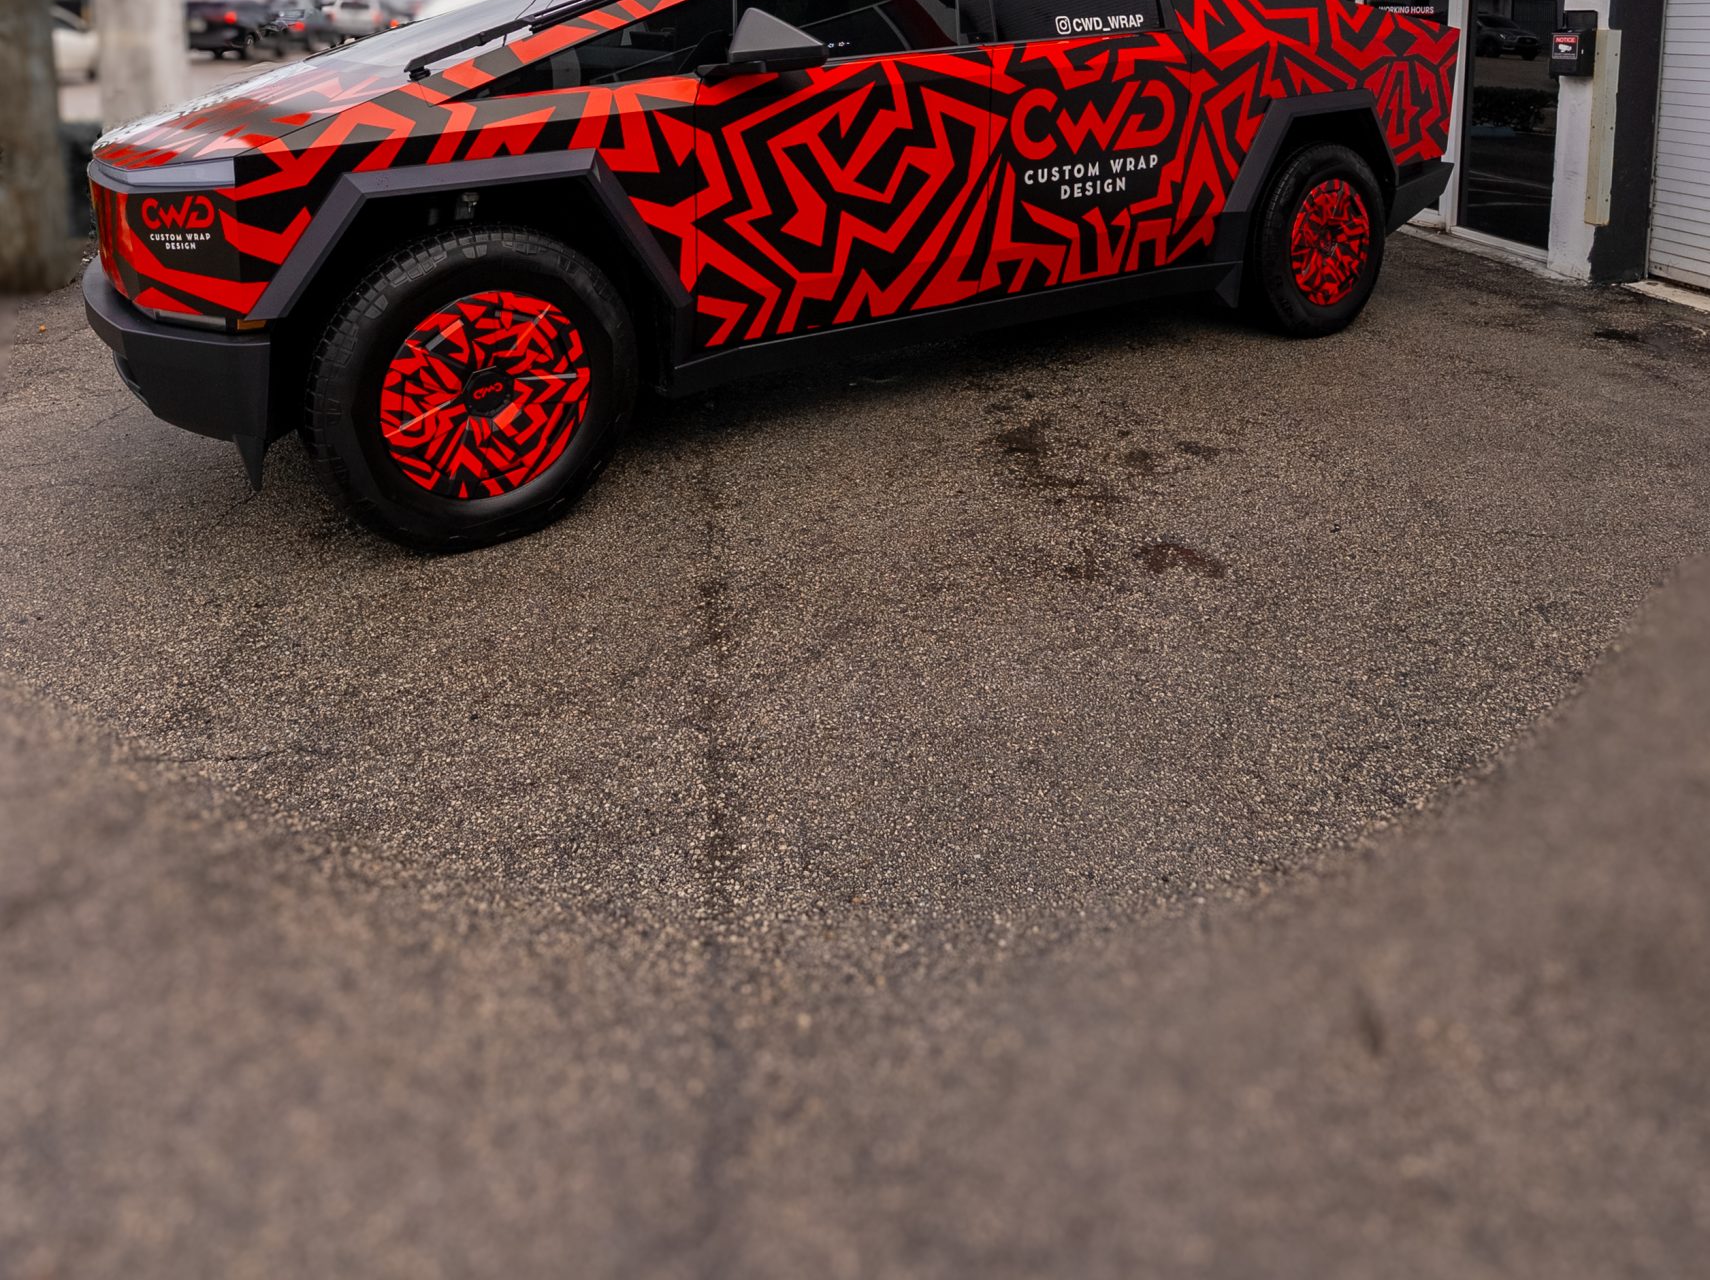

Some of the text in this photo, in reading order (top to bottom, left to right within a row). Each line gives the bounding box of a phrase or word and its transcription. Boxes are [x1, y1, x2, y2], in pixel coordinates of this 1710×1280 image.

[1410, 6, 1434, 14] HOURS
[1072, 14, 1144, 32] CWD_WRAP
[1010, 79, 1175, 160] CWD
[1024, 154, 1158, 185] CUSTOM WRAP
[1060, 177, 1126, 200] DESIGN
[142, 195, 215, 230] CWD
[149, 232, 211, 241] CUSTOM WRAP
[165, 242, 196, 250] DESIGN
